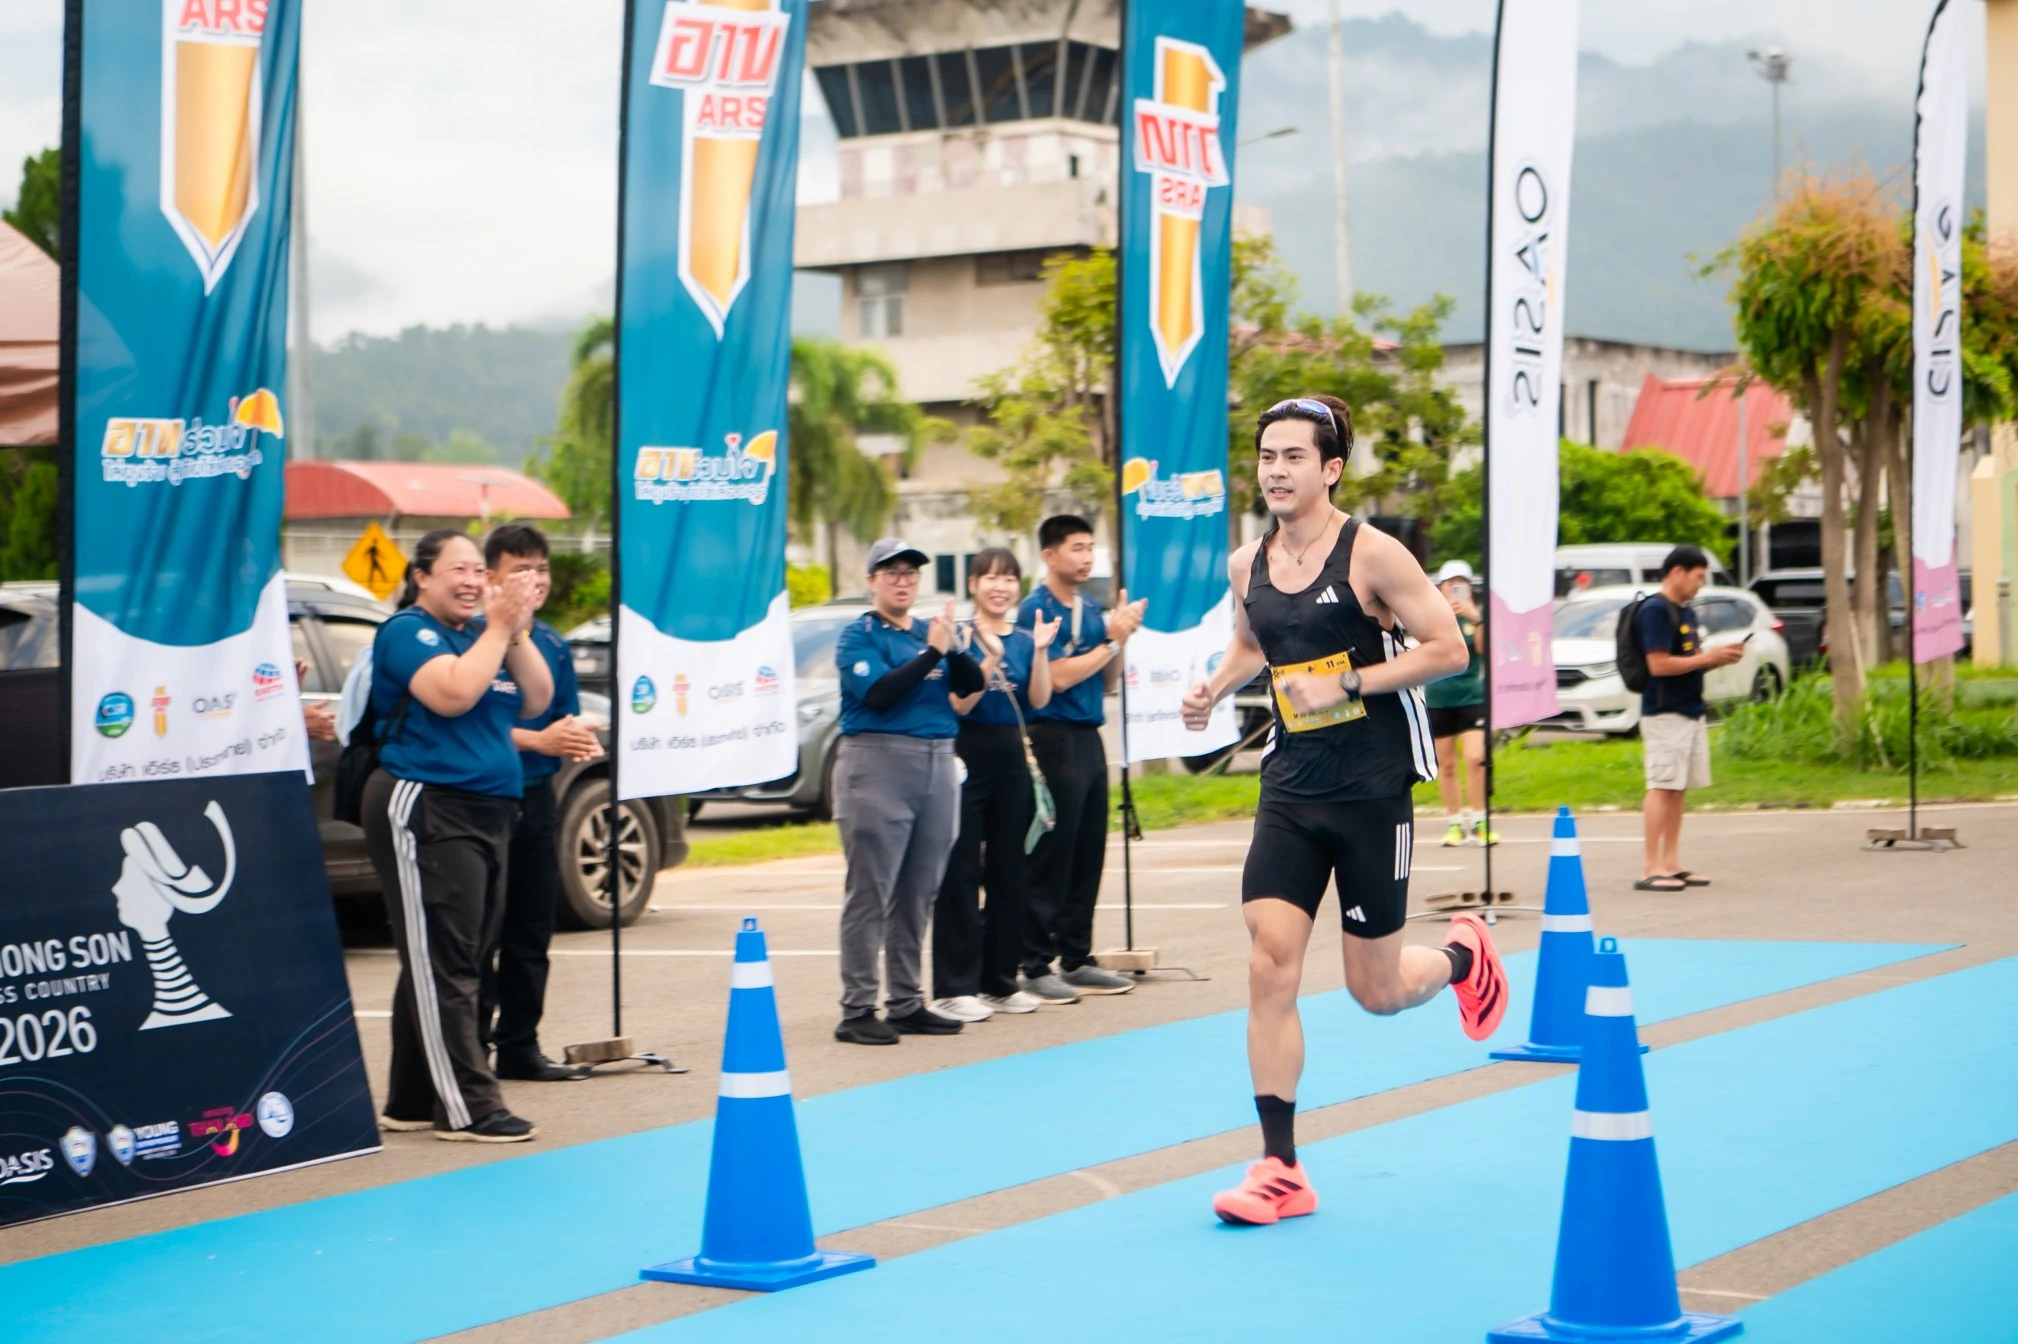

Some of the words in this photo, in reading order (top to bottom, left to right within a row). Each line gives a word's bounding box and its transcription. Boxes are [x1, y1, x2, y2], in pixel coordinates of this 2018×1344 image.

[179, 0, 267, 33] ARS
[697, 94, 765, 128] ARS
[0, 939, 67, 978] ONG
[69, 930, 133, 968] SON
[24, 972, 110, 1000] COUNTRY
[0, 1006, 97, 1066] 2026
